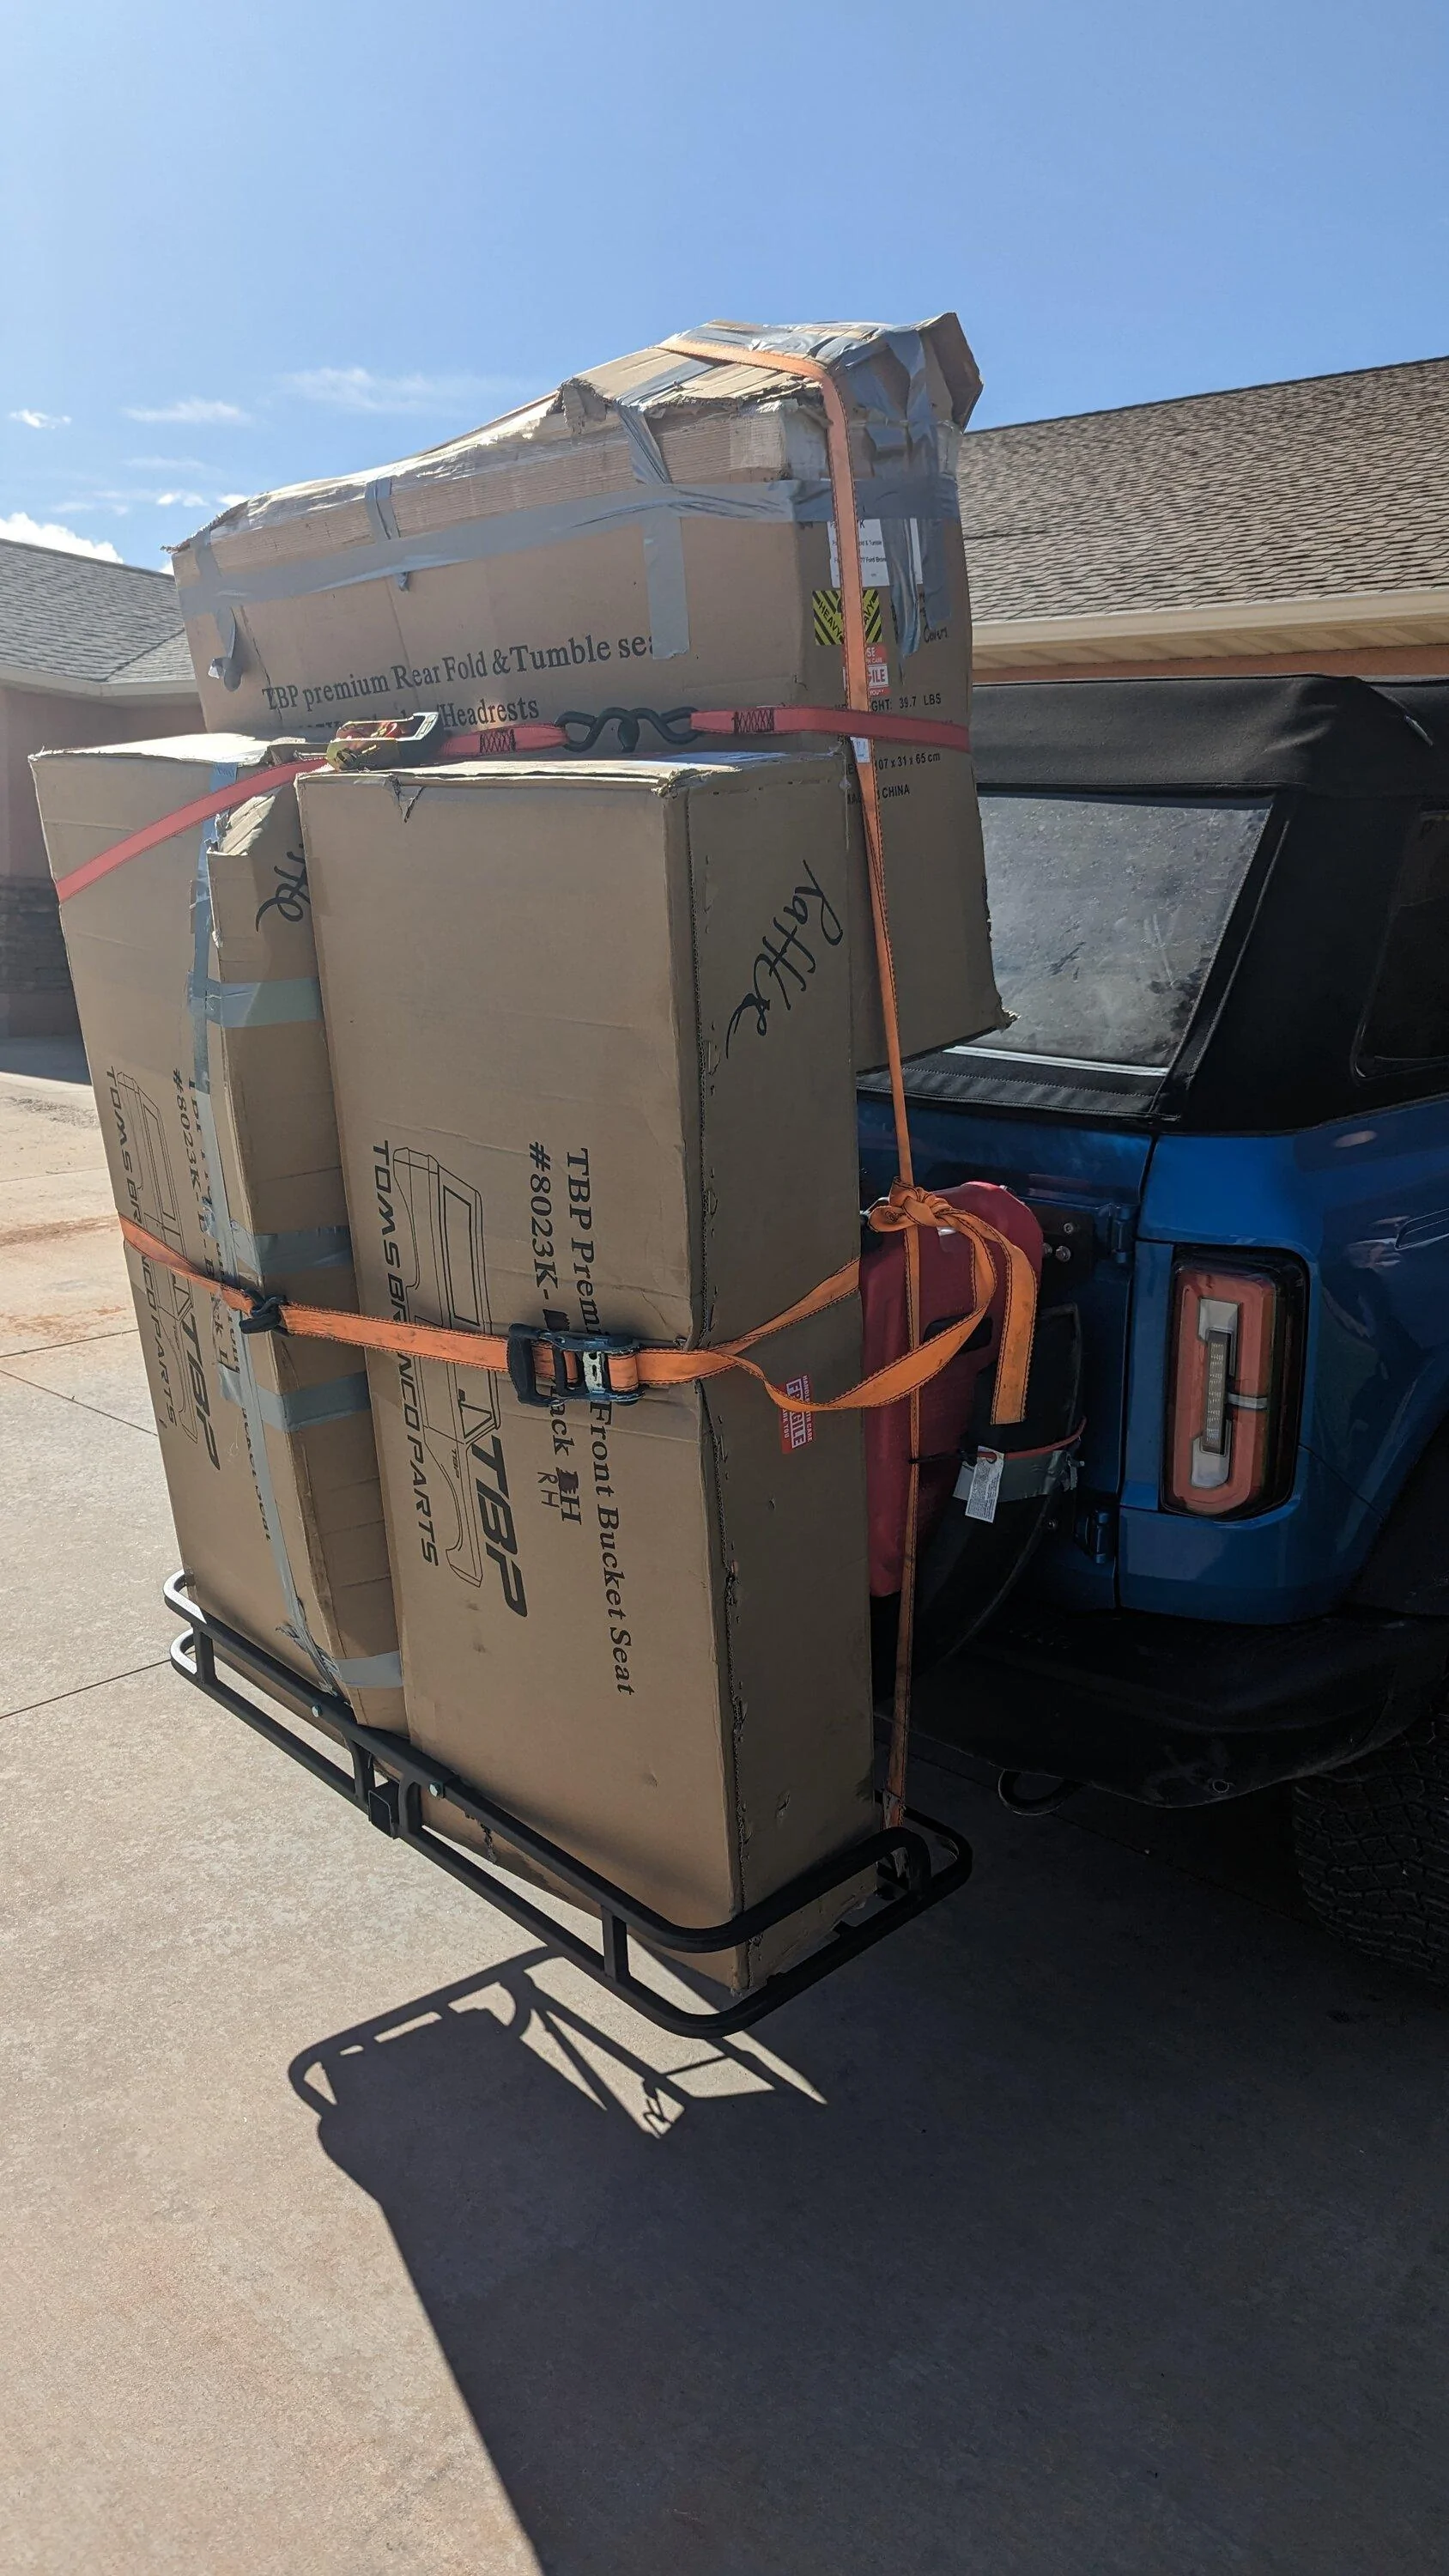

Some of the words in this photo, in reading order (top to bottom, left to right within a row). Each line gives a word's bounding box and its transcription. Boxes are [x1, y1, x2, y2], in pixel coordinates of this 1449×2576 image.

[818, 601, 842, 637] HEAVY
[863, 599, 876, 624] AVY
[262, 684, 299, 710] TBP
[303, 673, 391, 712] premium
[391, 665, 441, 690] Rear
[442, 650, 488, 682] Fold
[492, 647, 511, 676] &
[510, 635, 611, 672] Tumble
[618, 635, 653, 659] se
[870, 698, 893, 712] GHT:
[900, 696, 917, 709] 39.7
[923, 693, 942, 706] LBS
[439, 697, 539, 728] Headrests
[882, 783, 911, 799] CHINA
[915, 753, 926, 765] 65
[927, 752, 941, 762] cm
[566, 1147, 592, 1230] TBP
[106, 1066, 133, 1174] TOMS
[126, 1177, 158, 1311] BRNCO
[150, 1313, 178, 1427] PARTS
[373, 1139, 401, 1268] TOMS
[387, 1273, 421, 1431] BRNCO
[407, 1434, 440, 1566] PARTS
[181, 1312, 221, 1472] TBP
[788, 1381, 804, 1446] FRGILE
[451, 1448, 460, 1479] TBP
[589, 1401, 615, 1498] Front
[537, 1471, 561, 1509] RH
[471, 1435, 528, 1618] TBP
[597, 1504, 627, 1620] Bucket
[609, 1627, 635, 1696] Seat
